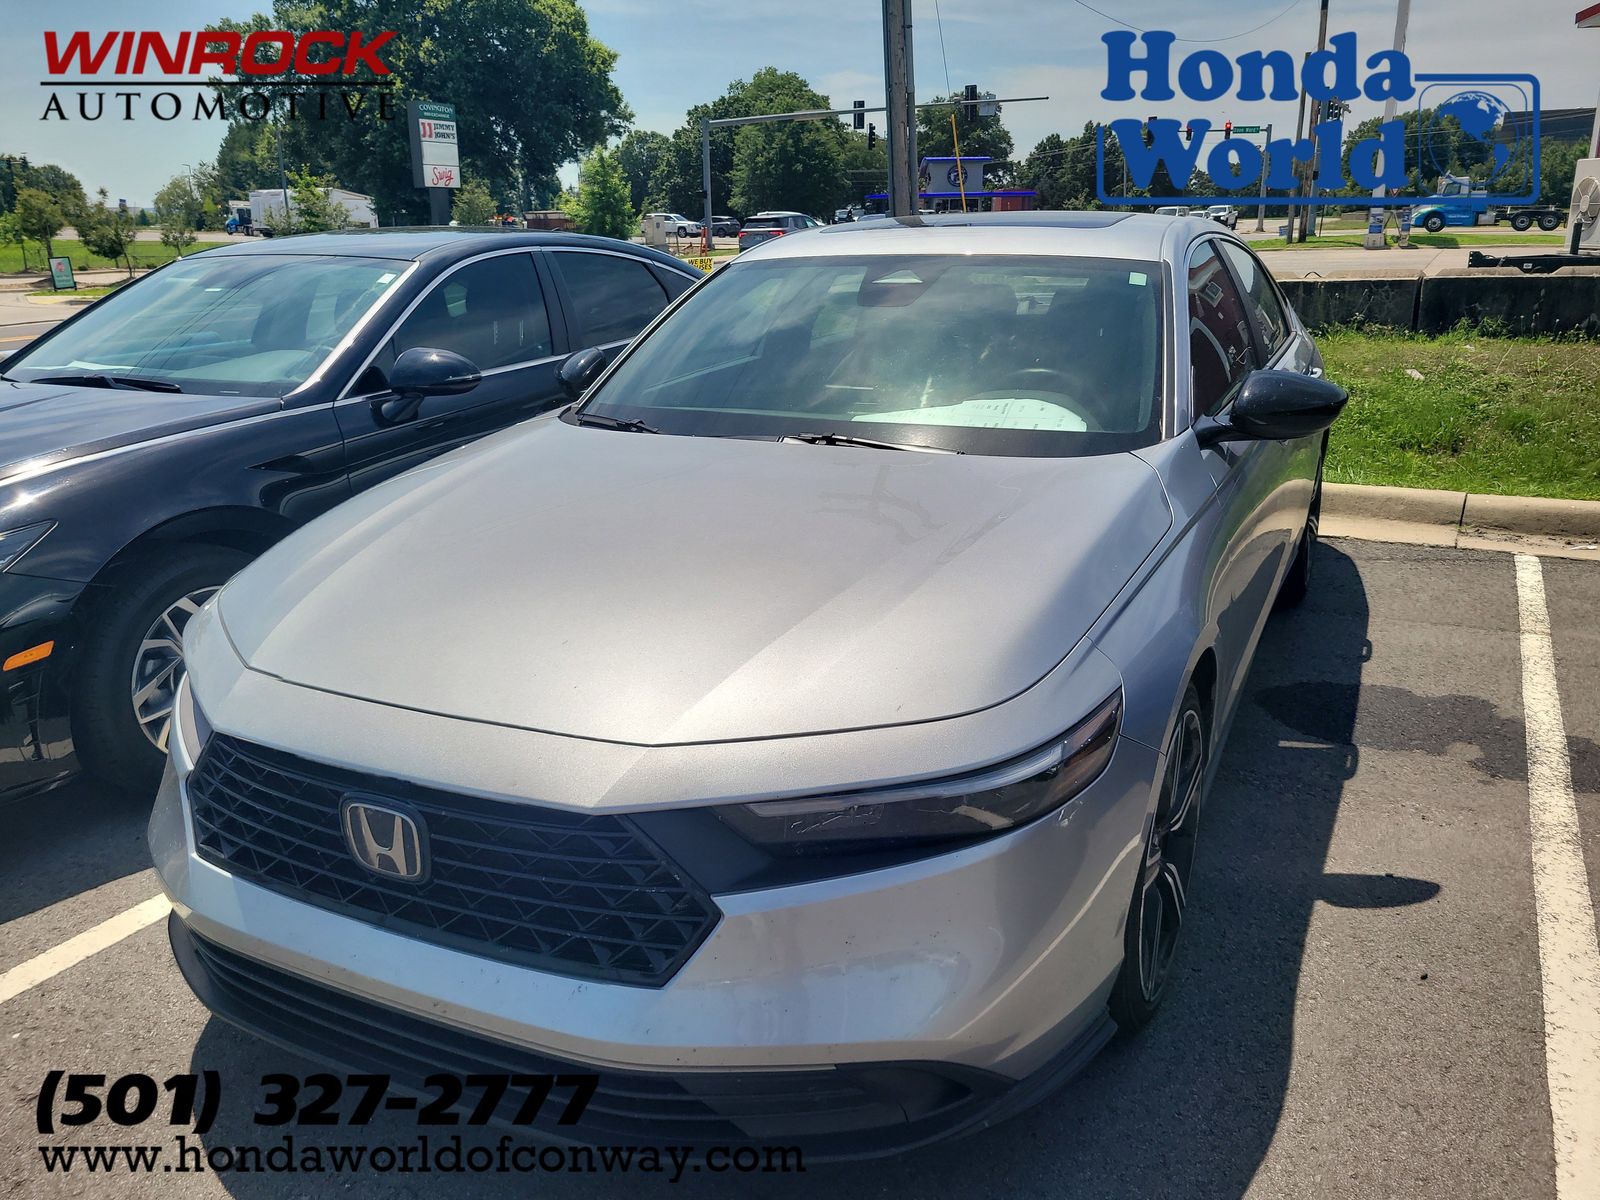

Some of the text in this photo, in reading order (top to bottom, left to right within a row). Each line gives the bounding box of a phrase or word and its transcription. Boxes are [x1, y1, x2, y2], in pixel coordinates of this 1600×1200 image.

[419, 104, 453, 112] COVINGTON
[434, 123, 455, 131] JIMMY
[432, 166, 454, 187] Swig
